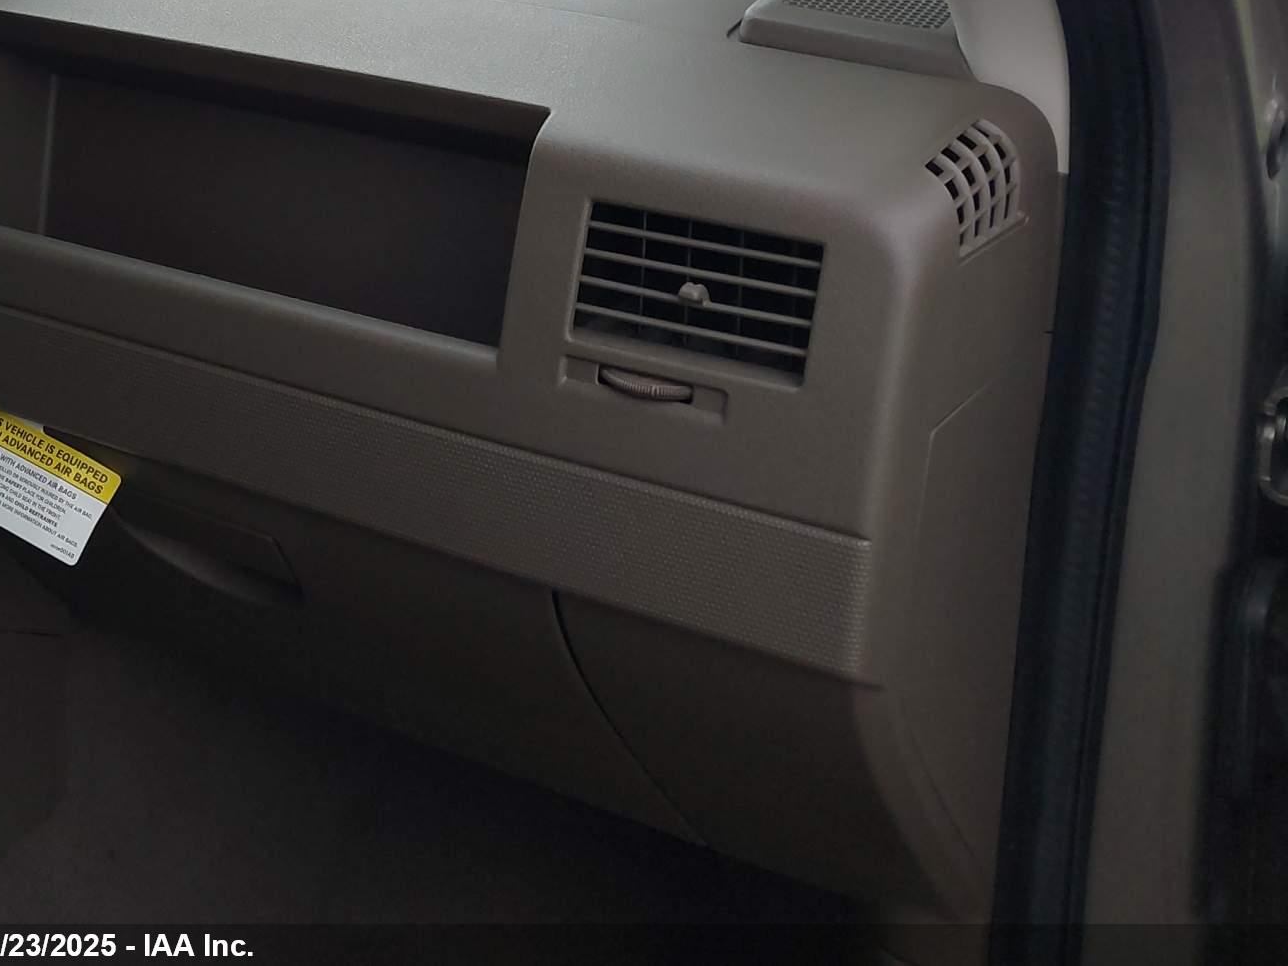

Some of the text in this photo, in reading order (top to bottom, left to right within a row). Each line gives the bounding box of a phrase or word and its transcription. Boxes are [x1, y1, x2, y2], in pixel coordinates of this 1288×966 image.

[0, 453, 16, 467] WITH
[14, 462, 48, 484] ADVANCED
[46, 479, 58, 489] AIR
[57, 485, 77, 500] BAGS
[1, 434, 54, 467] ADVANCED
[53, 461, 72, 477] AIR
[71, 472, 104, 494] BAGS
[2, 421, 46, 449] VEHICLE
[44, 443, 56, 455] IS
[54, 449, 110, 484] EQUIPPED
[73, 505, 82, 513] AIR
